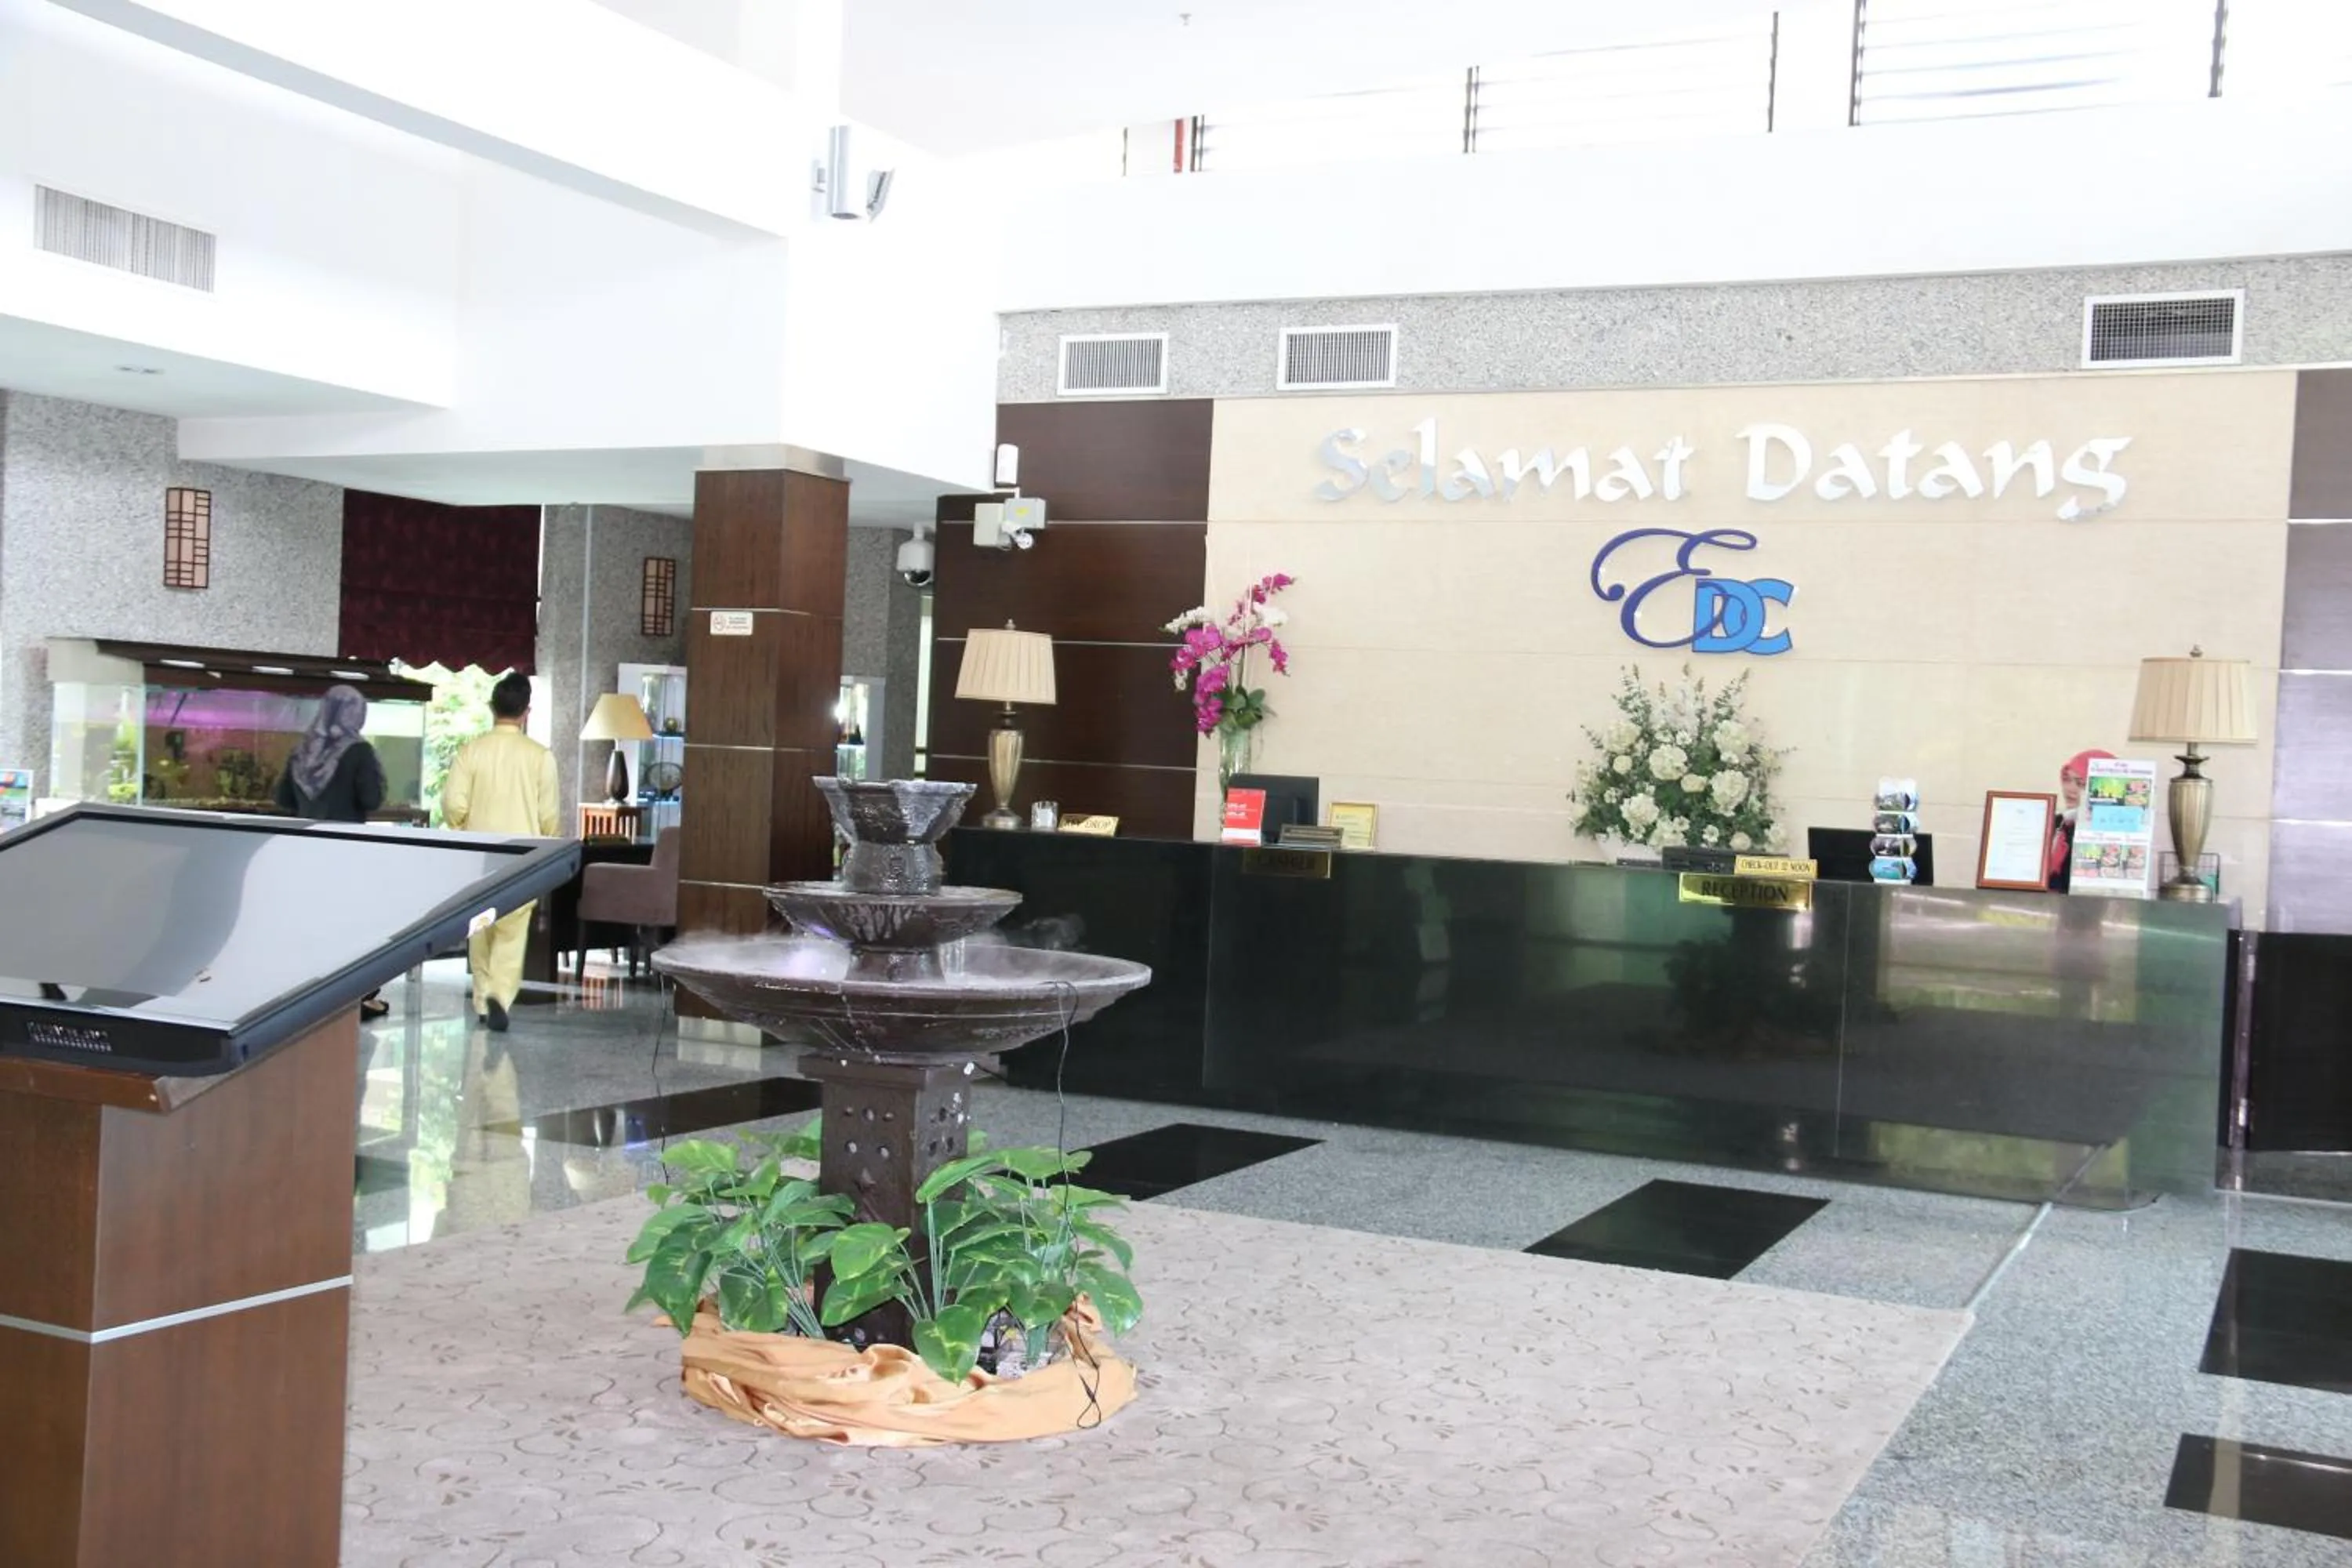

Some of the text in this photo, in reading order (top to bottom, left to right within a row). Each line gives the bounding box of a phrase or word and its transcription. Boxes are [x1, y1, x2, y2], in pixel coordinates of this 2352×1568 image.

[1314, 417, 2132, 521] Selamat Datang
[1701, 880, 1790, 902] RECEPTION
